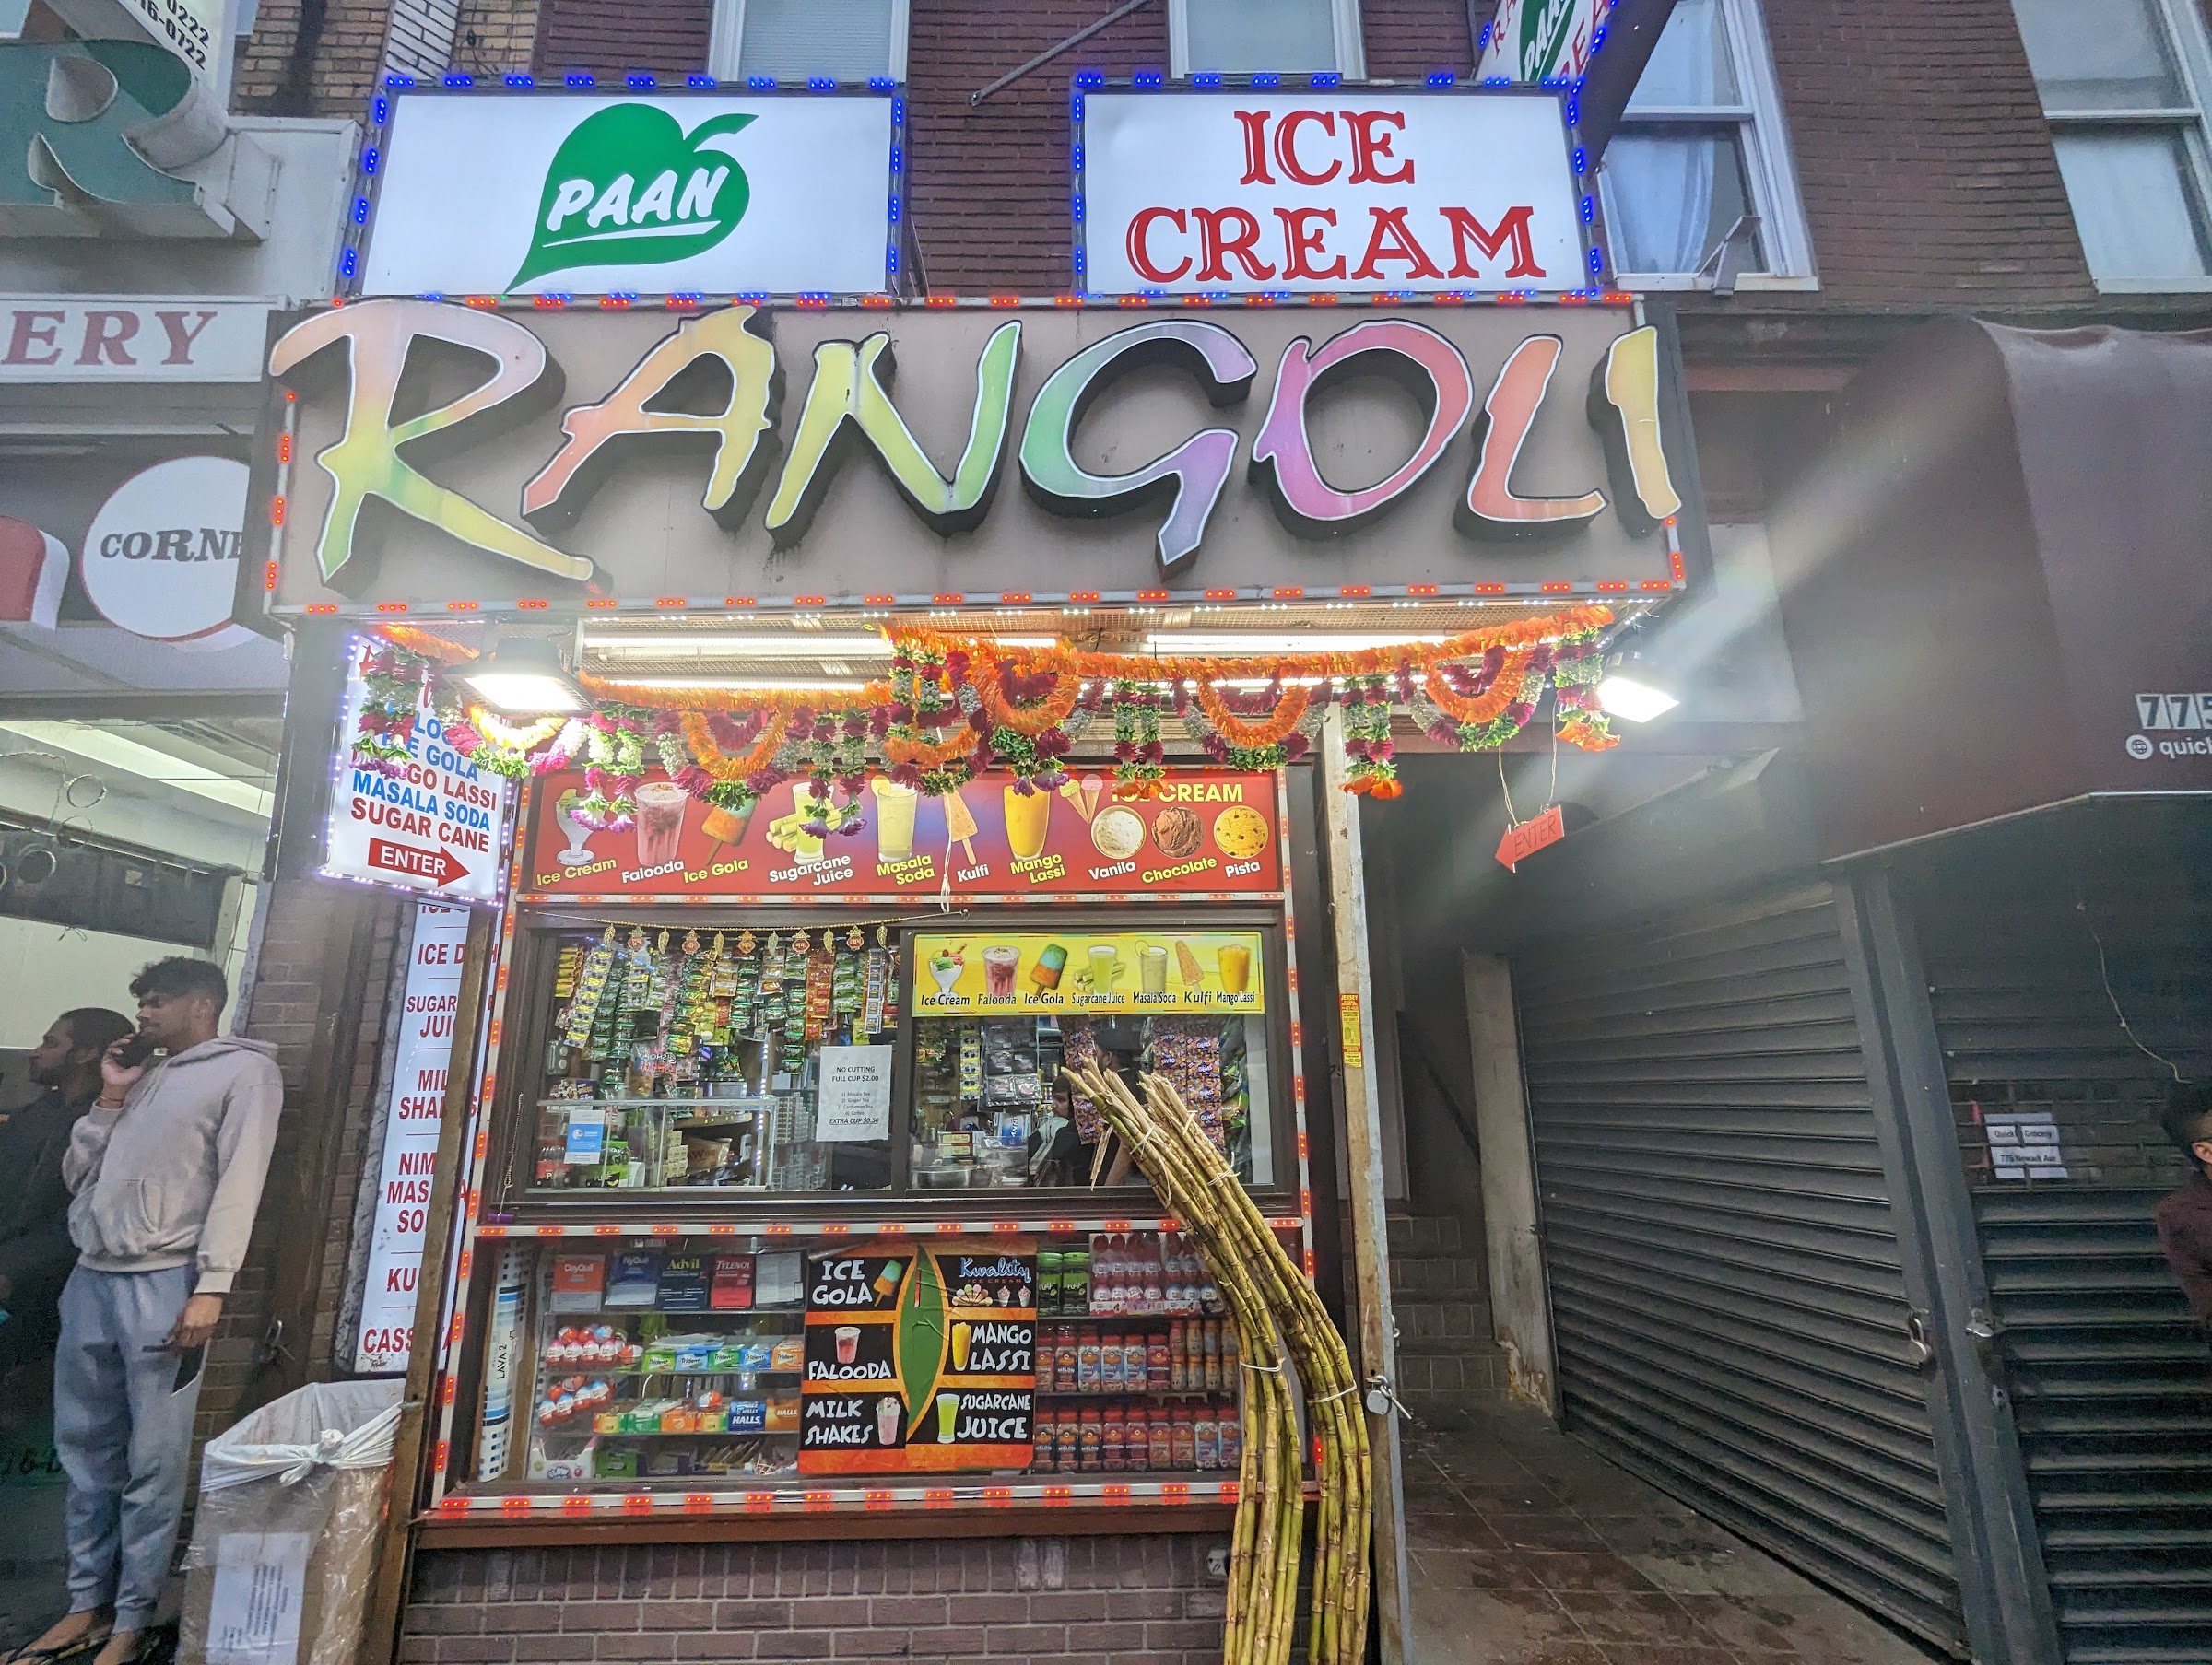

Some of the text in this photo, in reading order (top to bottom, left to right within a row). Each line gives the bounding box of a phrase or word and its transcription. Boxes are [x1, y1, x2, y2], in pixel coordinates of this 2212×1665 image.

[1233, 110, 1415, 185] ICE
[546, 166, 730, 232] PAAN
[1125, 205, 1547, 281] CREAM
[267, 297, 1683, 584] RANGOLI
[426, 745, 479, 782] GOLA
[353, 770, 490, 832] MASALA SODA
[443, 775, 497, 811] LASSI
[1158, 783, 1243, 803] CREAM
[350, 796, 490, 853] SUGAR CANE
[1513, 815, 1557, 857] ENTER
[380, 845, 447, 877] ENTER
[621, 859, 685, 884] Falooda
[683, 858, 749, 884] Ice Gola
[769, 854, 852, 883] Sugarcane
[876, 854, 933, 877] Masala
[1009, 853, 1063, 874] Mango
[1088, 860, 1137, 881] Vanila
[1141, 856, 1218, 884] Chocolate
[1224, 860, 1262, 879] Pista
[536, 858, 618, 886] Ice Cream
[813, 866, 854, 886] Juice
[895, 867, 935, 886] Soda
[956, 863, 990, 883] Kulfi
[1030, 863, 1066, 885] Lassi
[418, 944, 449, 965] ICE
[921, 994, 970, 1006] Ice Cream
[978, 993, 1017, 1005] Falooda
[1024, 992, 1064, 1004] Ice Gola
[1071, 992, 1125, 1006] Sugarcane Juice
[1133, 991, 1176, 1003] Masala Soda
[1184, 991, 1212, 1005] Kulfi
[1216, 991, 1255, 1005] Mango Lassi
[1994, 1130, 2015, 1138] Quick
[564, 1263, 594, 1273] DayQuil
[667, 1258, 700, 1270] Advil
[821, 1260, 865, 1281] ICE
[959, 1257, 1031, 1284] Kwality
[812, 1285, 873, 1305] GOLA
[971, 1322, 1031, 1344] MANGO
[808, 1360, 892, 1380] FALOODA
[970, 1349, 1030, 1371] LASSI
[806, 1400, 864, 1418] MILK
[960, 1393, 1031, 1411] SUGARCANE
[805, 1425, 874, 1445] SHAKES
[957, 1416, 1028, 1439] JUICE
